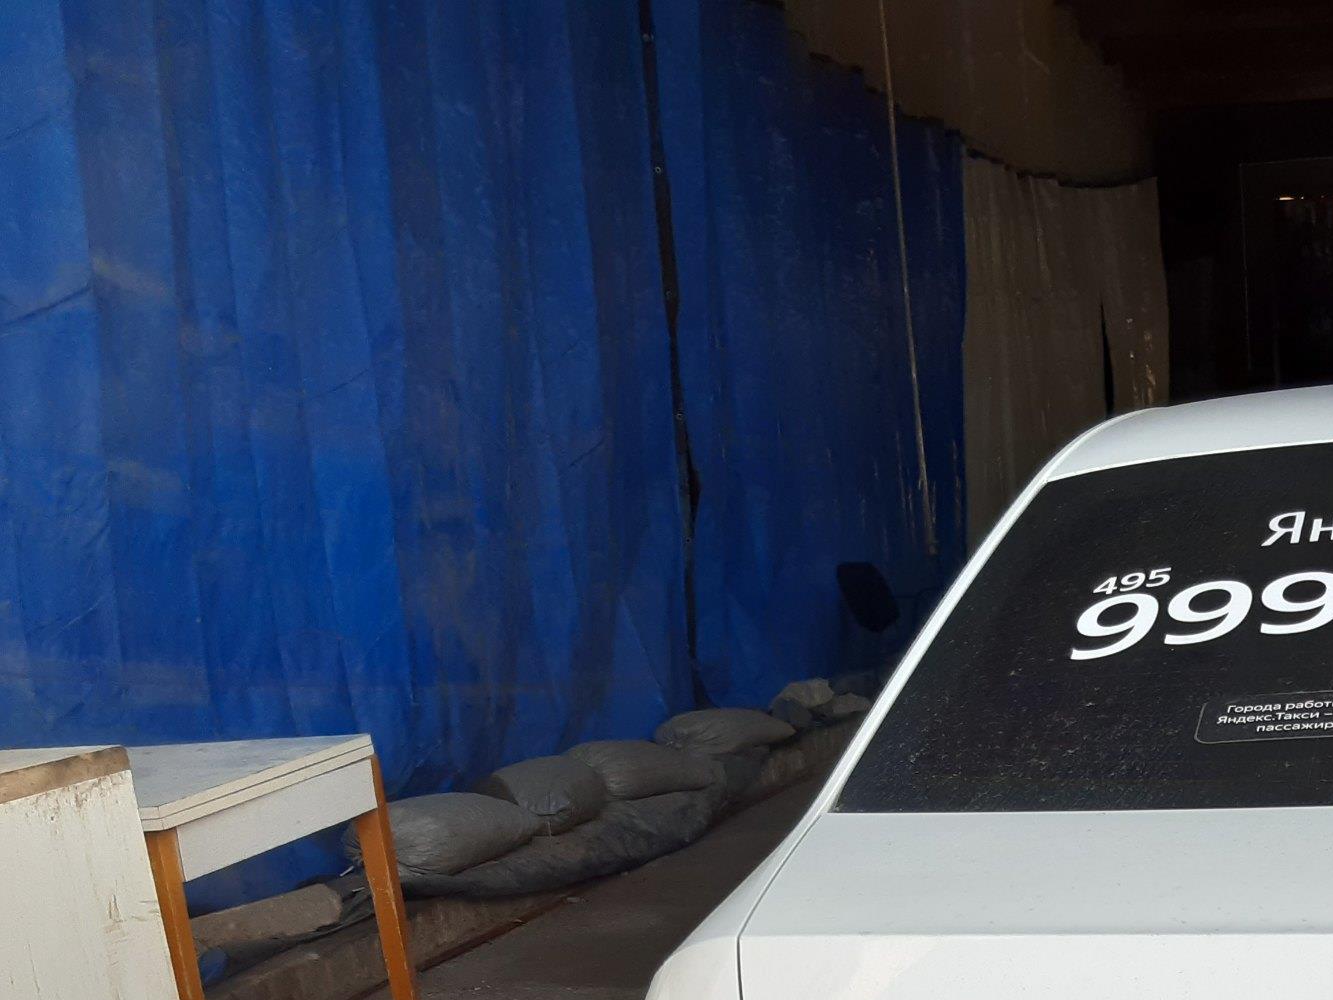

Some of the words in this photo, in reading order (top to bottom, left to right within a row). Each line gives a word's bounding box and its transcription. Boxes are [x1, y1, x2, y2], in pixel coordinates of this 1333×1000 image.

[1094, 567, 1173, 596] 495
[1226, 703, 1282, 714] Города
[1216, 711, 1320, 725] Яндекс.Такси
